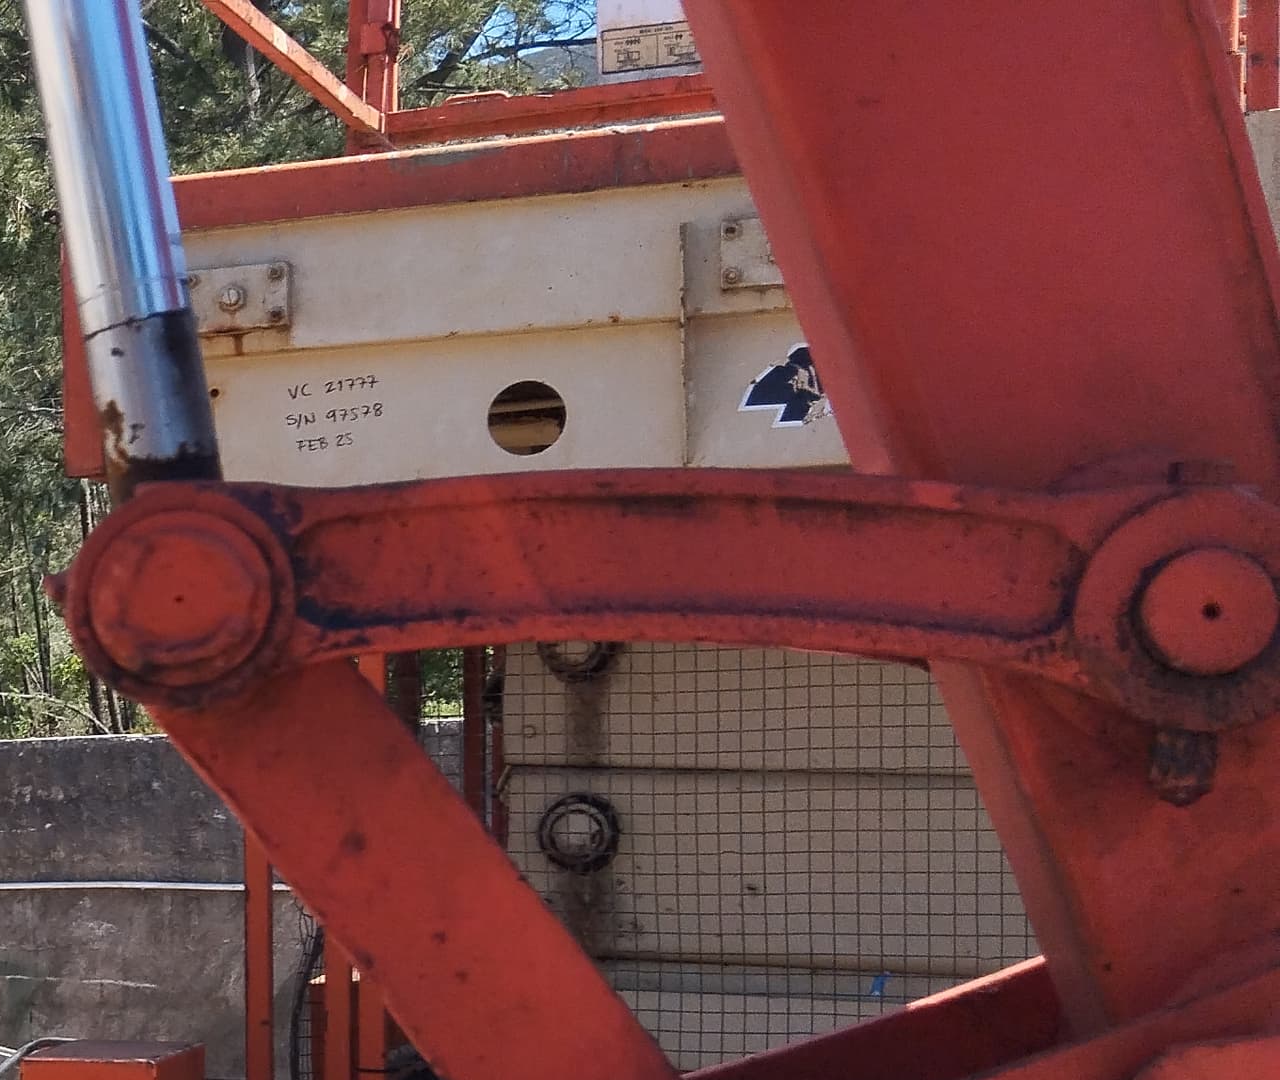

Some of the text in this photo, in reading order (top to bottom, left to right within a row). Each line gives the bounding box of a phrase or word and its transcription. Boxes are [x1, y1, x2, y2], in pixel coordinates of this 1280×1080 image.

[288, 375, 380, 400] VC 21777
[286, 402, 383, 429] S/N 97578
[296, 432, 354, 452] FEB 25
